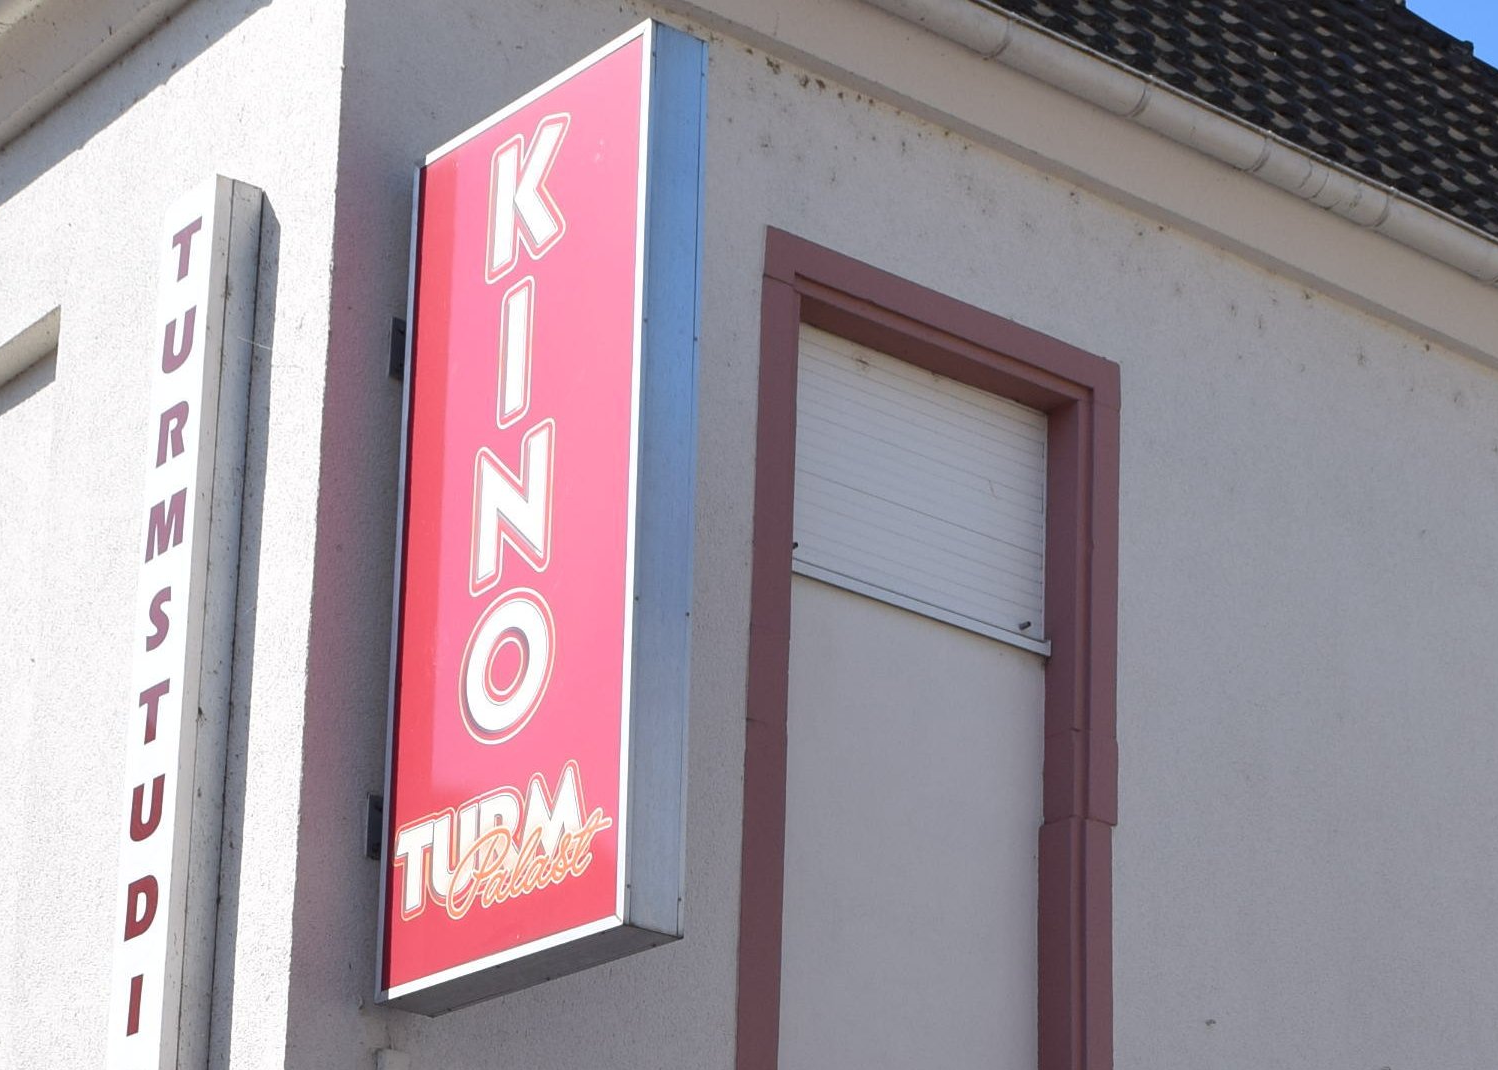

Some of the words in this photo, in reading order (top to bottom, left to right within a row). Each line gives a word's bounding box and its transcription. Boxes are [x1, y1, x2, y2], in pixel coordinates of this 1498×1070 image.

[461, 113, 570, 744] KINO
[394, 760, 586, 920] TURM
[446, 807, 612, 919] Palast
